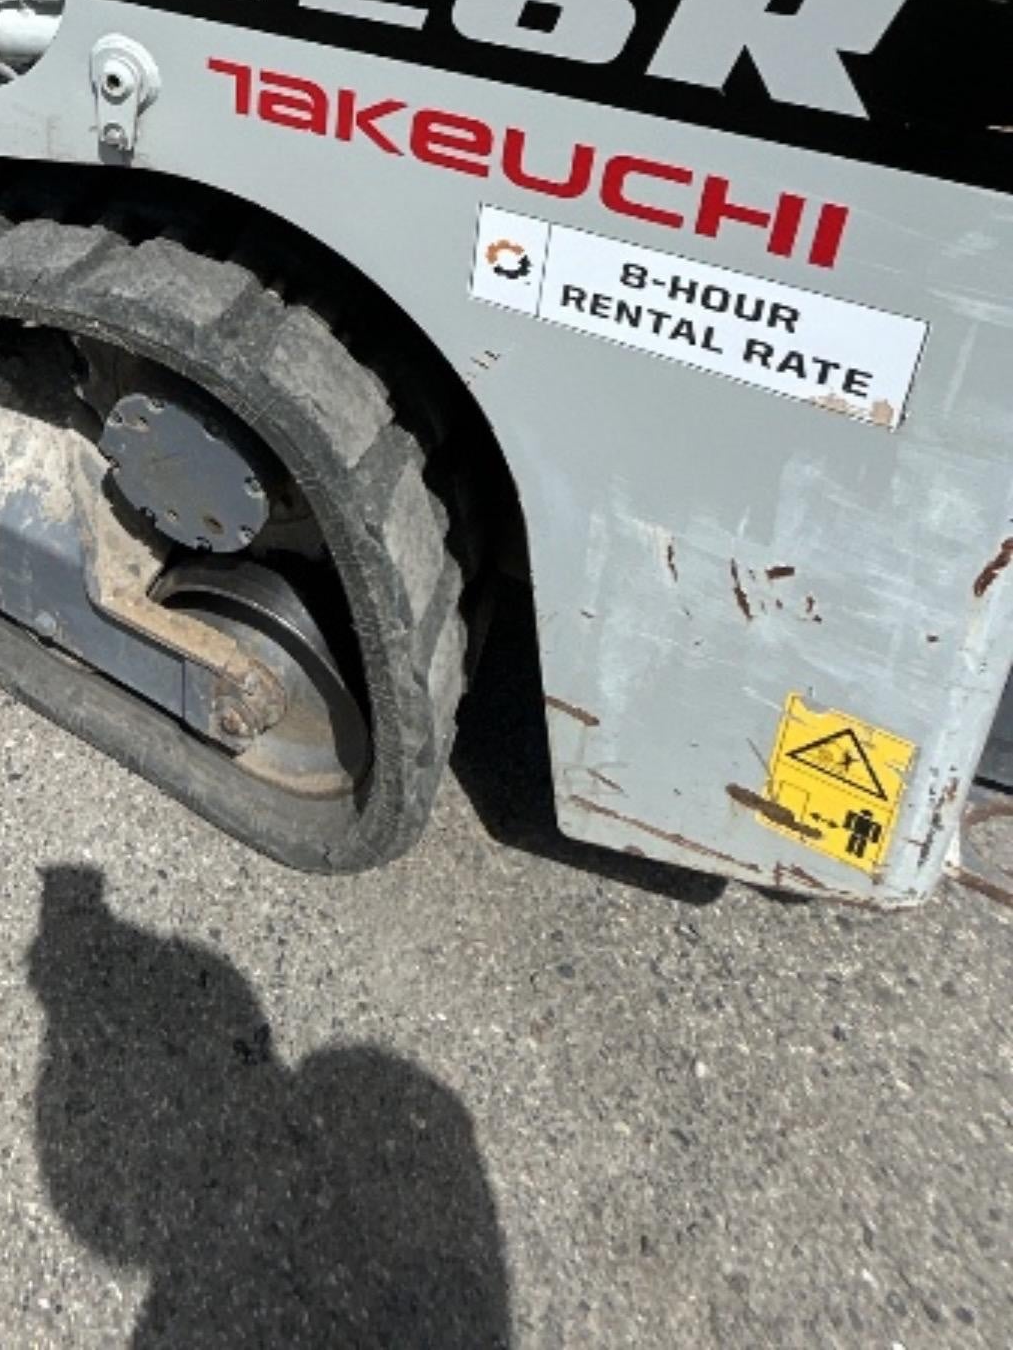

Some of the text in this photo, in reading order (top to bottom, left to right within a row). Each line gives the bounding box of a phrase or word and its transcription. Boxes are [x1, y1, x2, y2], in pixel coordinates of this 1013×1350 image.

[560, 284, 874, 397] RENTAL RATE
[620, 262, 802, 333] 8-HOUR
